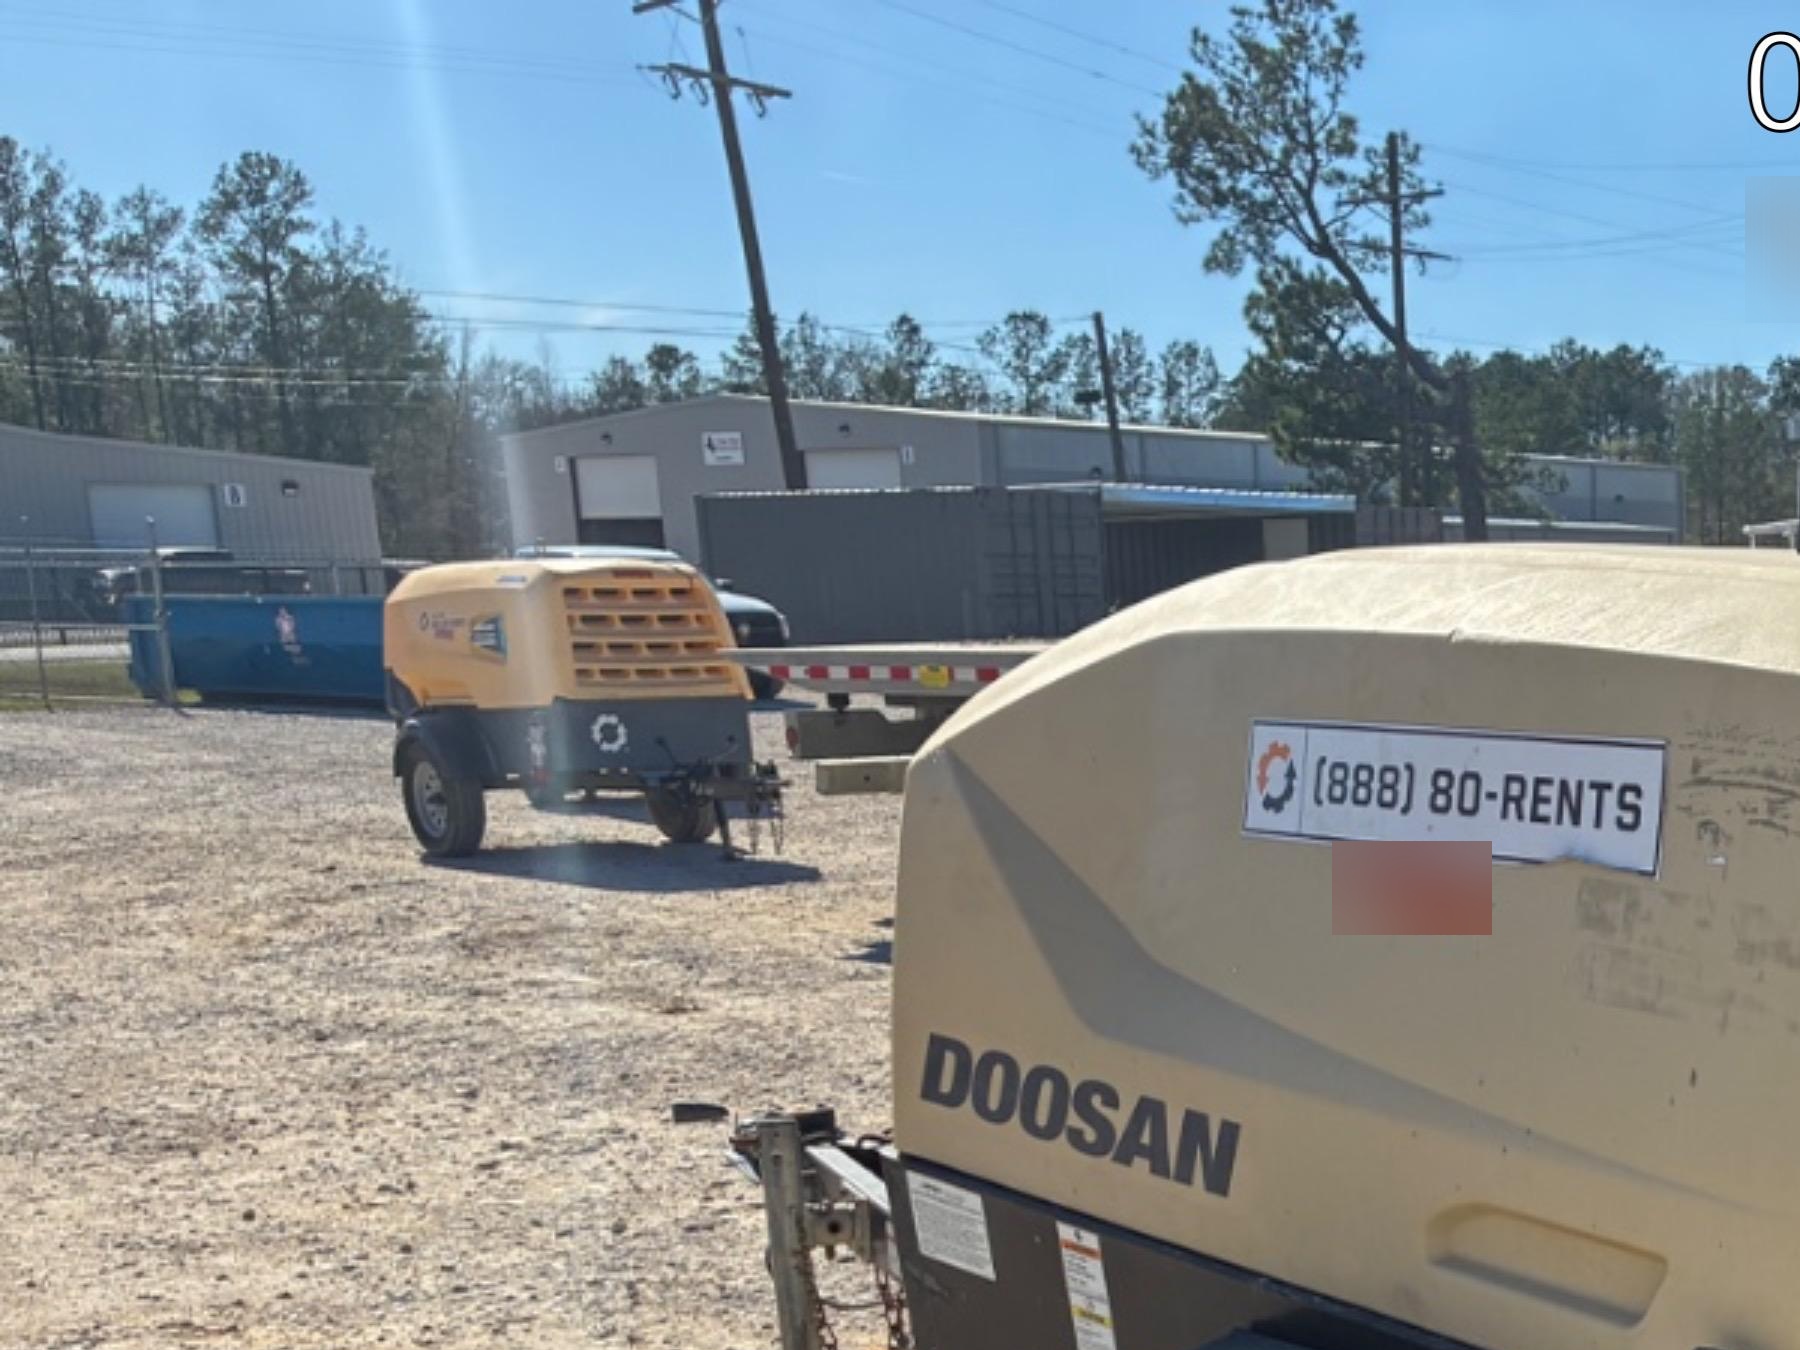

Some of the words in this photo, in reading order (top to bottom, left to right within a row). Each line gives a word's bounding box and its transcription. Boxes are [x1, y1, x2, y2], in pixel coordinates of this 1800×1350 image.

[1313, 755, 1415, 816] (888)
[1428, 768, 1644, 832] 80-RENTS
[920, 1033, 1242, 1198] DOOSAN
